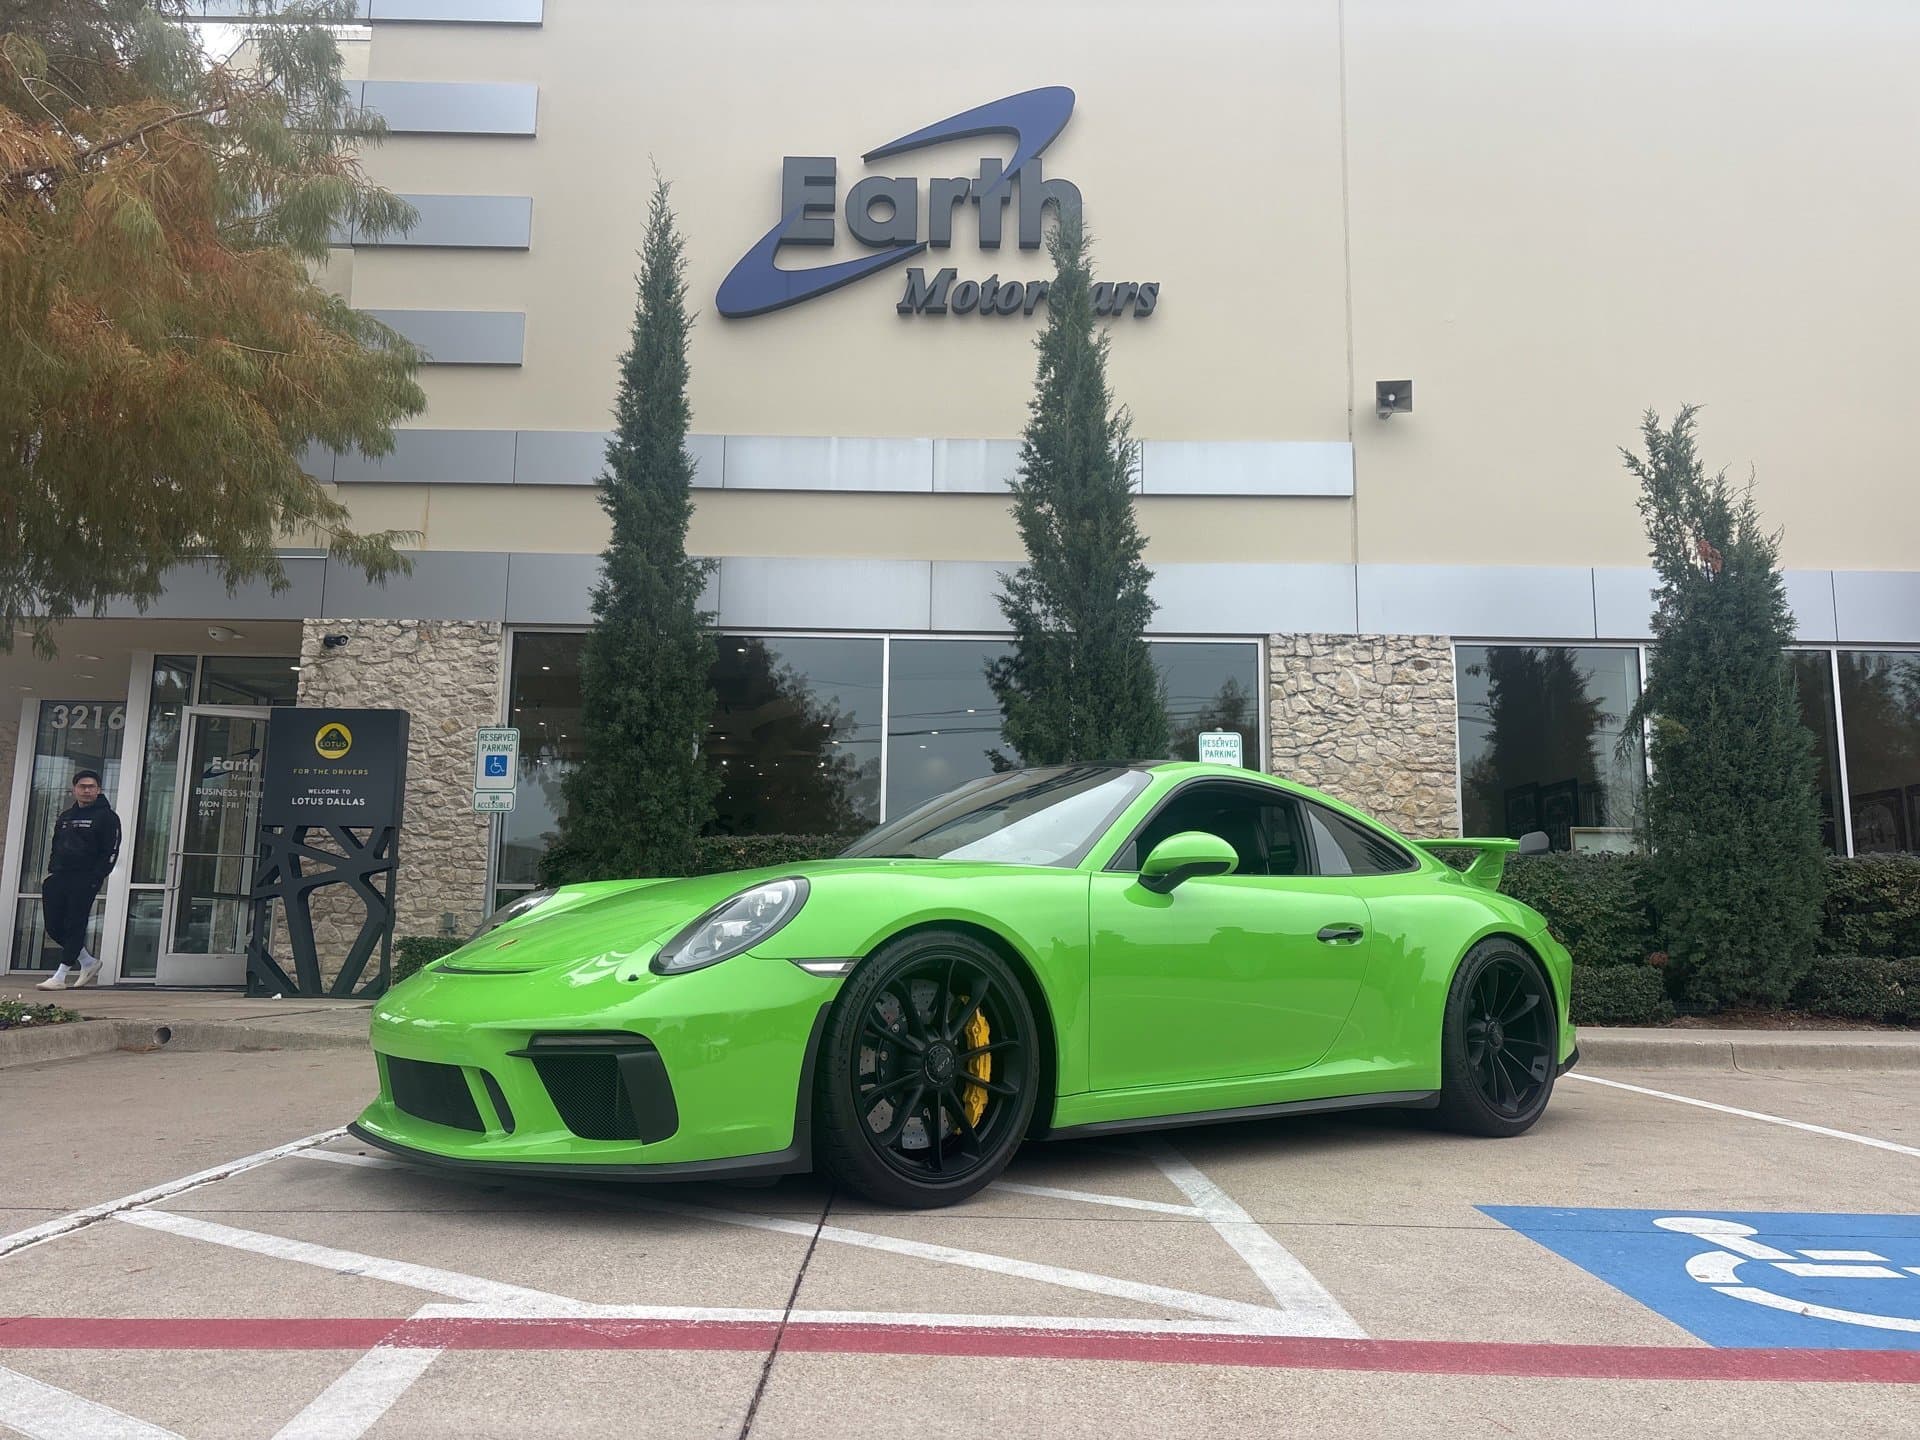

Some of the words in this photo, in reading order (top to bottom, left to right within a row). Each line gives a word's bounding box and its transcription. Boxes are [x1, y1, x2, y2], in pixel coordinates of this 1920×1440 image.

[780, 155, 1083, 249] Earth
[896, 267, 1161, 318] Motorars
[51, 704, 126, 730] 3216
[480, 733, 517, 742] RESERVED
[481, 743, 513, 752] PARKING
[1202, 739, 1239, 748] RESERVED
[1204, 749, 1237, 759] PARKING
[212, 756, 259, 772] Earth
[195, 787, 238, 797] BUSINESS
[199, 800, 220, 808] MON
[226, 801, 240, 809] FRI
[291, 797, 323, 805] LOTUS
[326, 797, 366, 806] DALLAS
[477, 801, 511, 809] ACCESSIBLE
[198, 809, 216, 817] SAT
